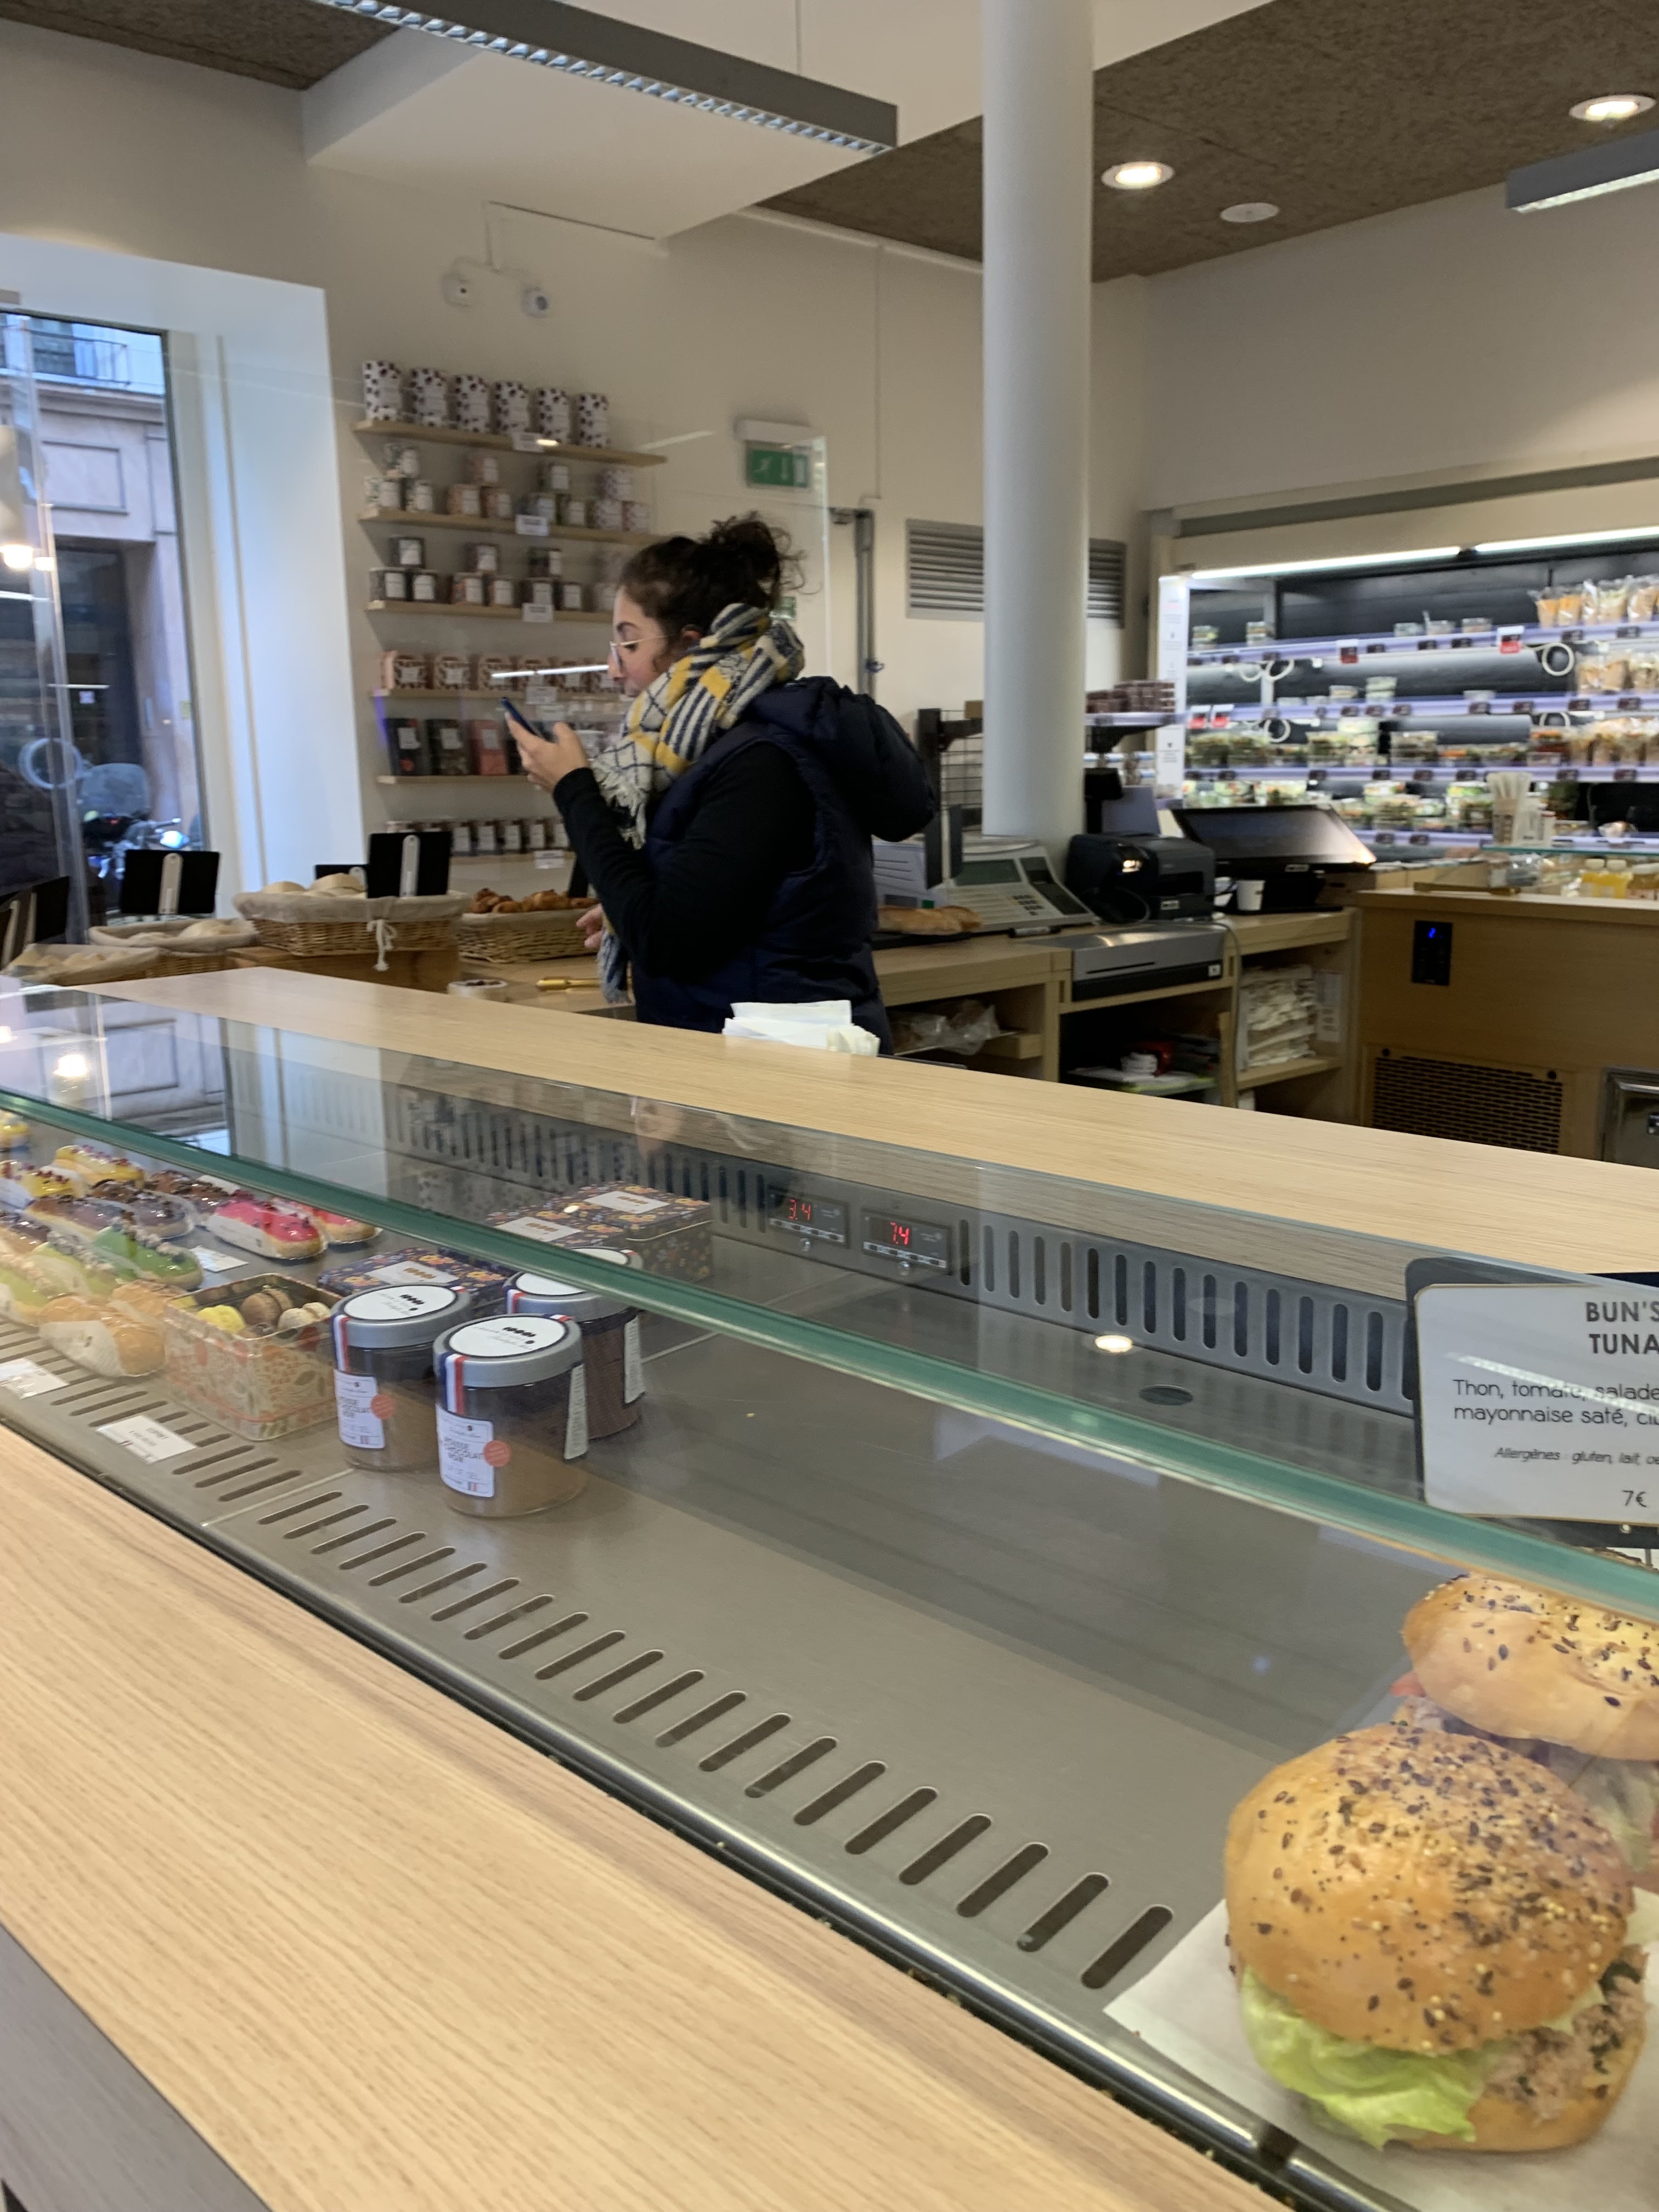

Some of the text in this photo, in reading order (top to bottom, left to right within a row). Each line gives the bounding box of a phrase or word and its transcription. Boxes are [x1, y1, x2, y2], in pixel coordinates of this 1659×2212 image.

[788, 1199, 811, 1221] 3.4
[889, 1221, 910, 1245] 7.4
[1585, 1301, 1659, 1323] BUN'S
[1589, 1333, 1659, 1355] TUNA
[1453, 1379, 1504, 1399] Thon,
[1594, 1383, 1659, 1400] salade
[1454, 1406, 1573, 1425] mayonnaise
[1581, 1406, 1627, 1427] saté,
[1621, 1489, 1647, 1508] 7€
